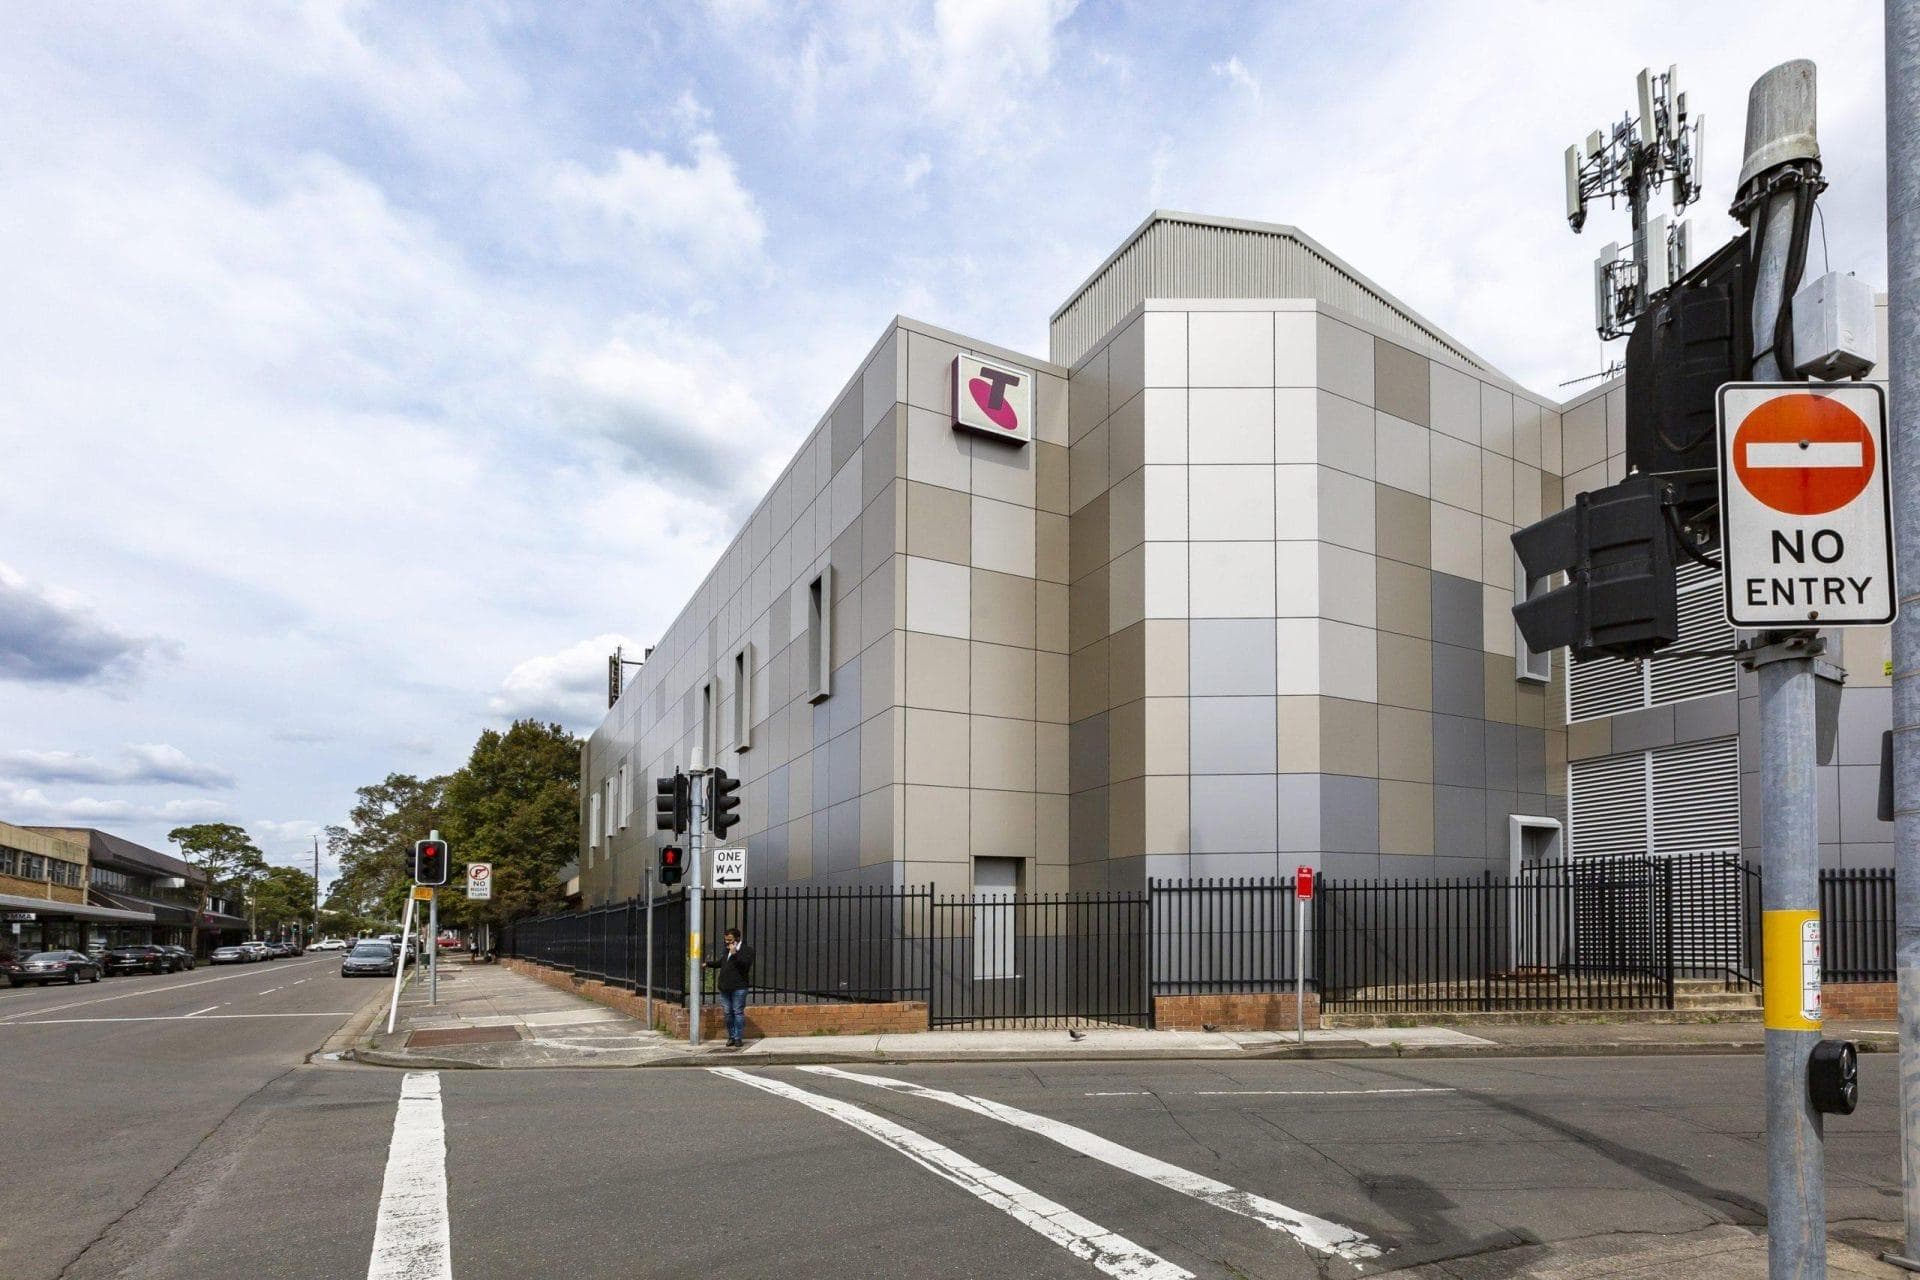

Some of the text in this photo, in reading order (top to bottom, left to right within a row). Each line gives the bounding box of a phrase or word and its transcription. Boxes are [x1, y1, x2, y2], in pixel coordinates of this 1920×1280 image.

[1771, 529, 1845, 564] NO
[1746, 576, 1873, 606] ENTRY
[718, 851, 741, 861] ONE
[716, 864, 742, 873] WAY
